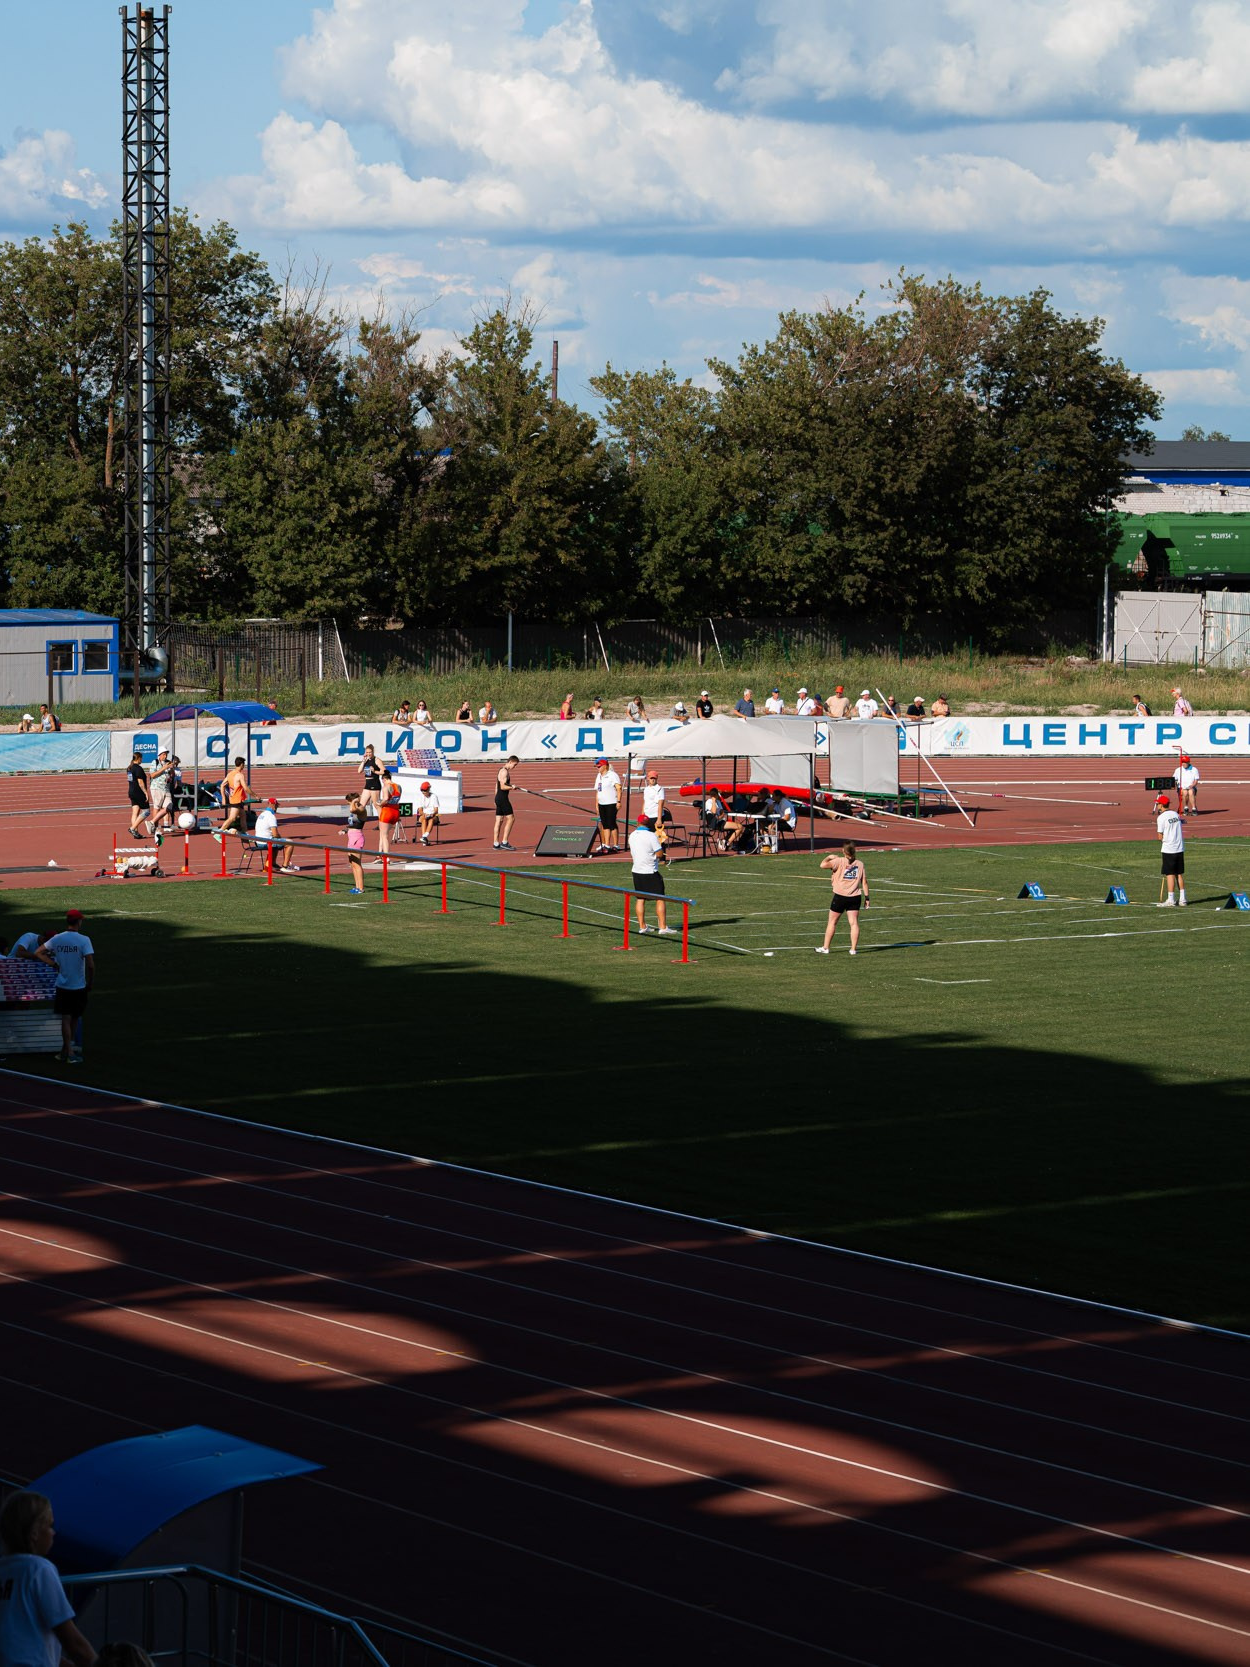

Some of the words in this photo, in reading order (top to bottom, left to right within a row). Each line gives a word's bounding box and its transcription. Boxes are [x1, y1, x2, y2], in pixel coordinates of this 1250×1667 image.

[206, 727, 508, 757] СТАДИОН
[1001, 723, 1181, 749] ЦЕНТР
[1208, 722, 1250, 745] С
[134, 743, 157, 751] ДЕСНА
[1029, 886, 1044, 898] 12
[1113, 889, 1127, 902] 14
[1237, 897, 1250, 910] 16
[56, 945, 78, 954] СУДЬЯ
